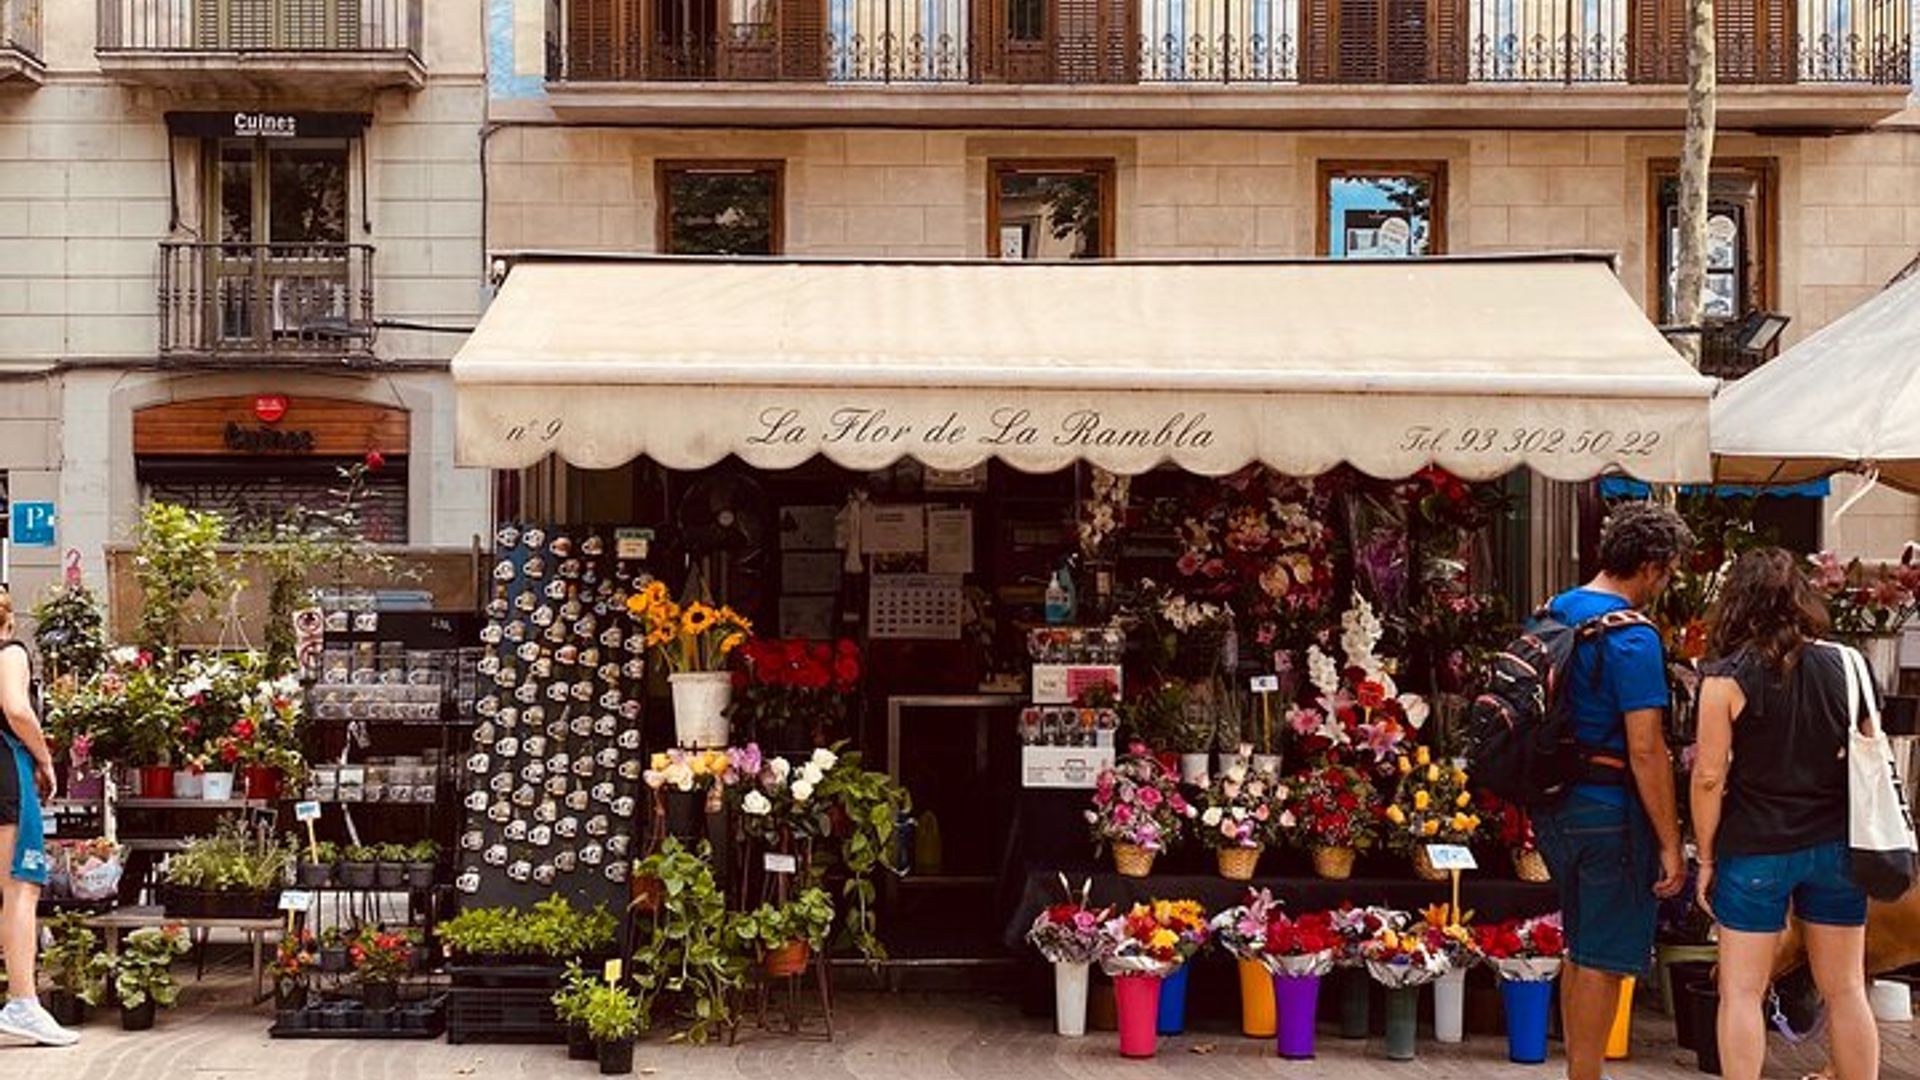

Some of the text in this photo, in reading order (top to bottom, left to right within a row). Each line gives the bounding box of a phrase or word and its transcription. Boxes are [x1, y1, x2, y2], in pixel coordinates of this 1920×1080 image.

[234, 112, 296, 130] Cuines
[746, 406, 1214, 448] La Flor de La Rambla
[1454, 426, 1499, 452] 93
[1502, 428, 1566, 453] 302
[1570, 430, 1614, 454] 50
[1616, 430, 1661, 456] 22
